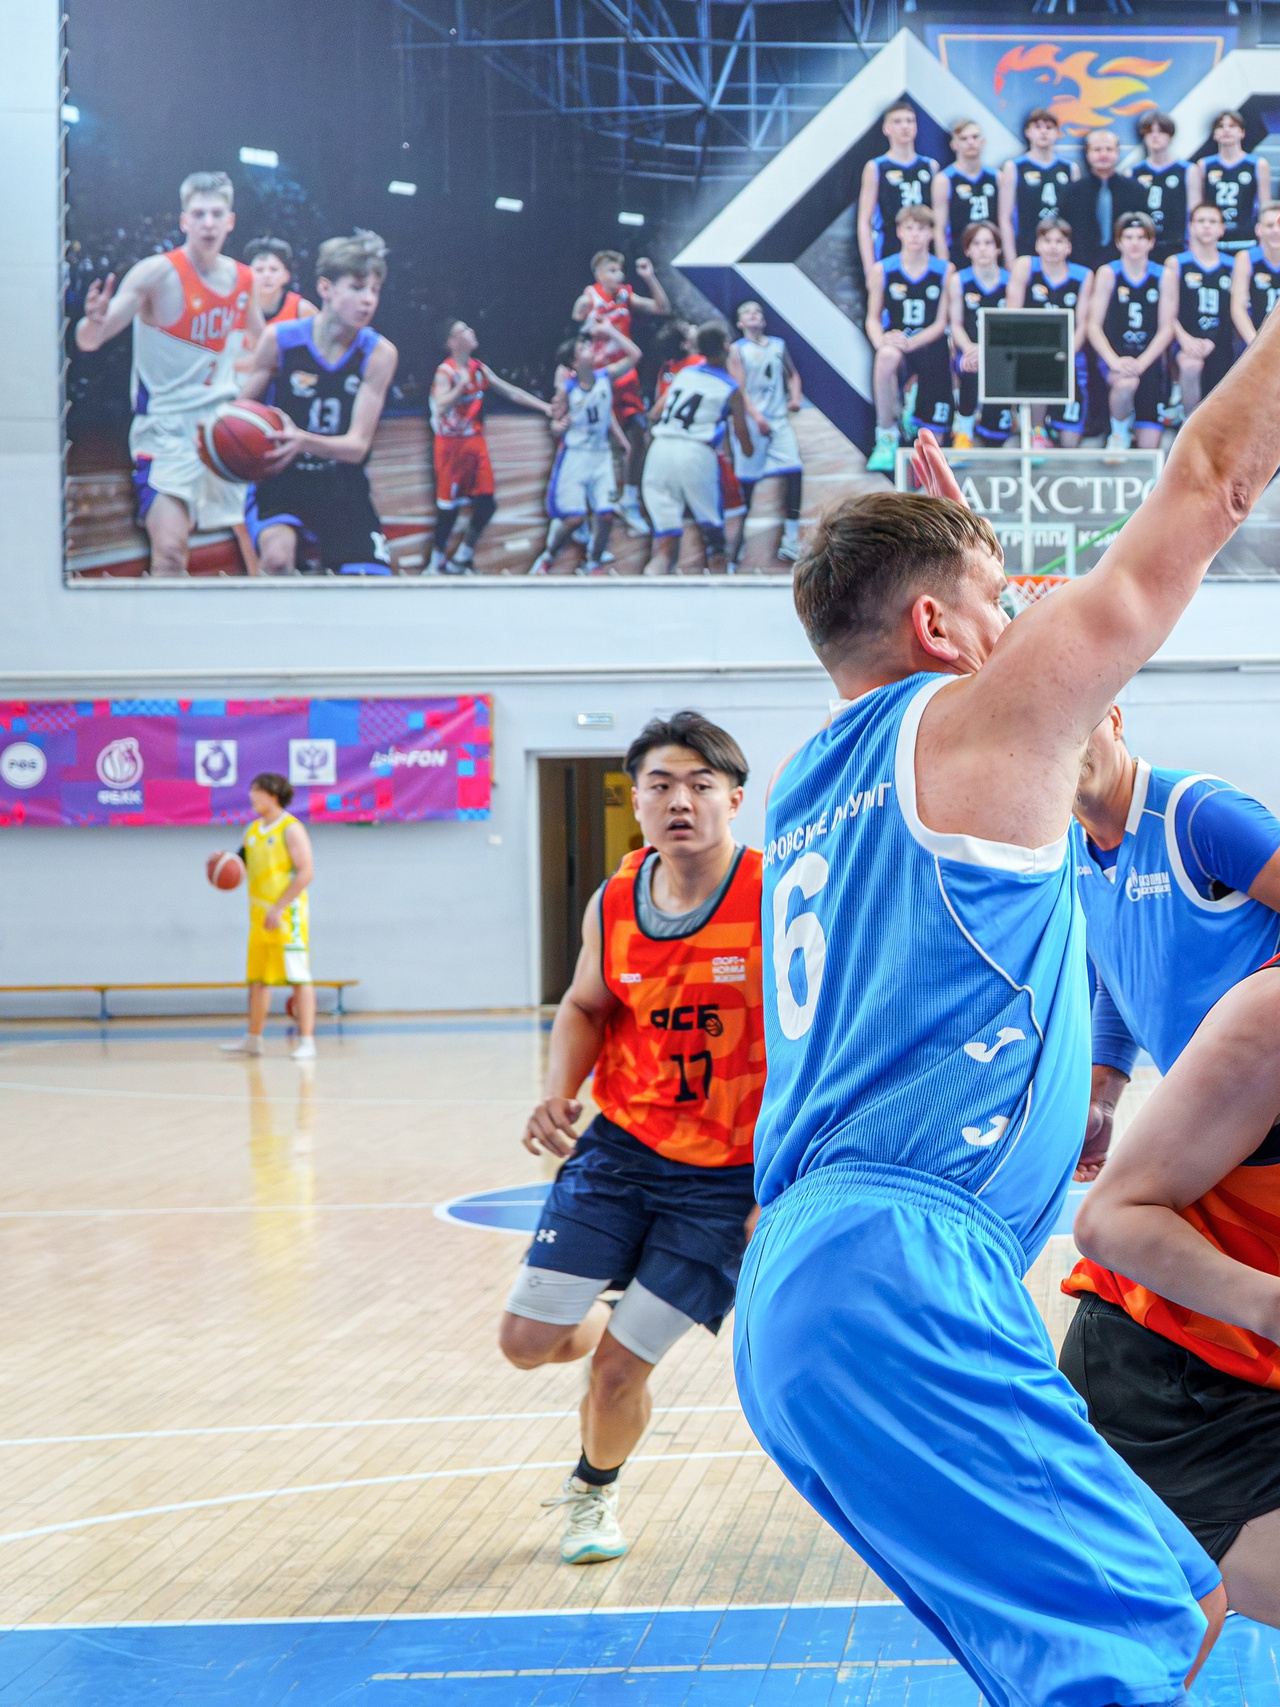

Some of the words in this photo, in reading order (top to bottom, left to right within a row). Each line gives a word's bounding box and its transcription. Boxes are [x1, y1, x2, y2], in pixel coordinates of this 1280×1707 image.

[1215, 181, 1239, 206] 22
[773, 852, 829, 1040] 6
[670, 1051, 713, 1103] 17
